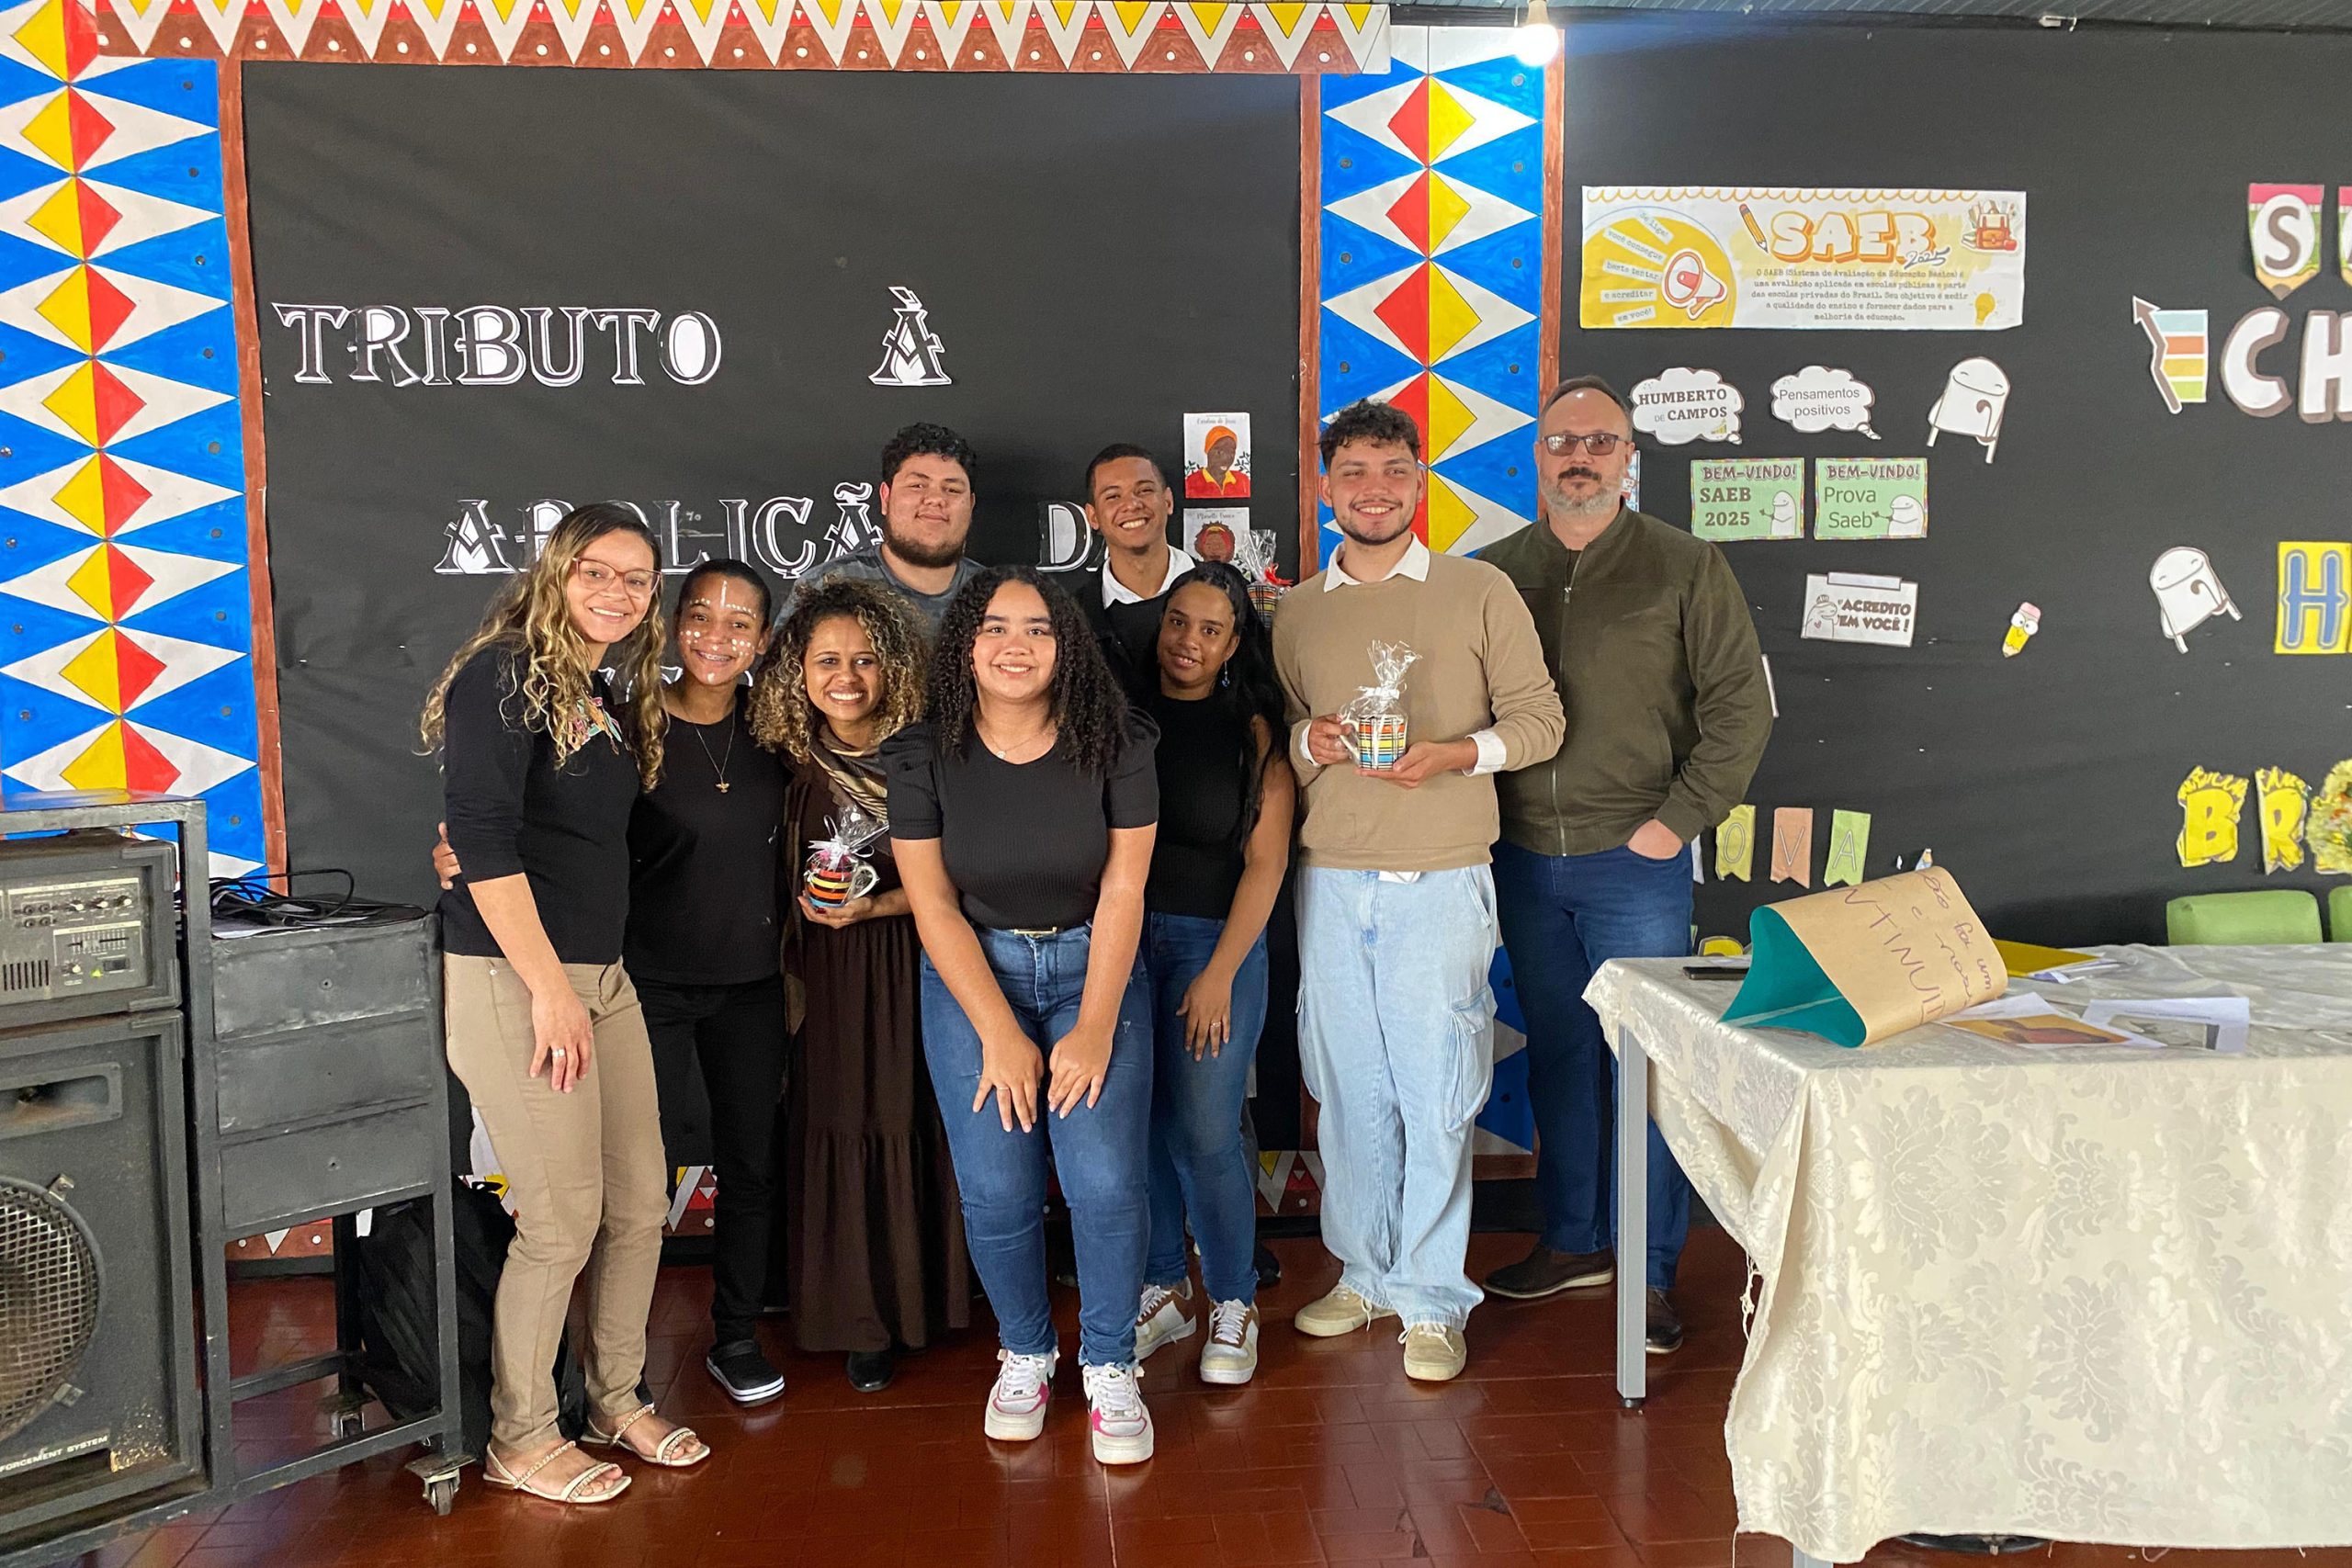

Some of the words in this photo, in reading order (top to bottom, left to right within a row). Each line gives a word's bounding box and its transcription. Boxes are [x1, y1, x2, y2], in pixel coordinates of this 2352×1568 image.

[1770, 210, 1937, 265] SAEB
[1626, 240, 1663, 261] consegue
[1904, 246, 1951, 269] 2025
[1815, 280, 1852, 289] aplicada
[1611, 289, 1654, 299] acreditar
[1768, 290, 1798, 299] escolas
[1801, 291, 1838, 300] privadas
[1900, 291, 1937, 301] objetivo
[1773, 302, 1815, 310] qualidade
[1866, 302, 1901, 310] fornecer
[271, 302, 722, 388] TRIBUTO
[868, 287, 952, 387] À
[1638, 389, 1727, 405] HUMBERTO
[1780, 388, 1860, 400] Pensamentos
[1655, 414, 1665, 423] DE
[1668, 406, 1727, 422] CAMPOS
[1794, 404, 1850, 419] positivos
[1702, 464, 1796, 480] BEM-VINDO!
[1826, 464, 1919, 480] BEM-VINDO!
[1700, 487, 1751, 502] SAEB
[1824, 487, 1876, 502] Prova
[1705, 512, 1750, 526] 2025
[1828, 511, 1872, 528] Saeb
[1035, 501, 1109, 572] D
[2282, 549, 2349, 649] H
[1862, 616, 1900, 632] VOCÊ
[67, 1435, 108, 1452] SYSTEM
